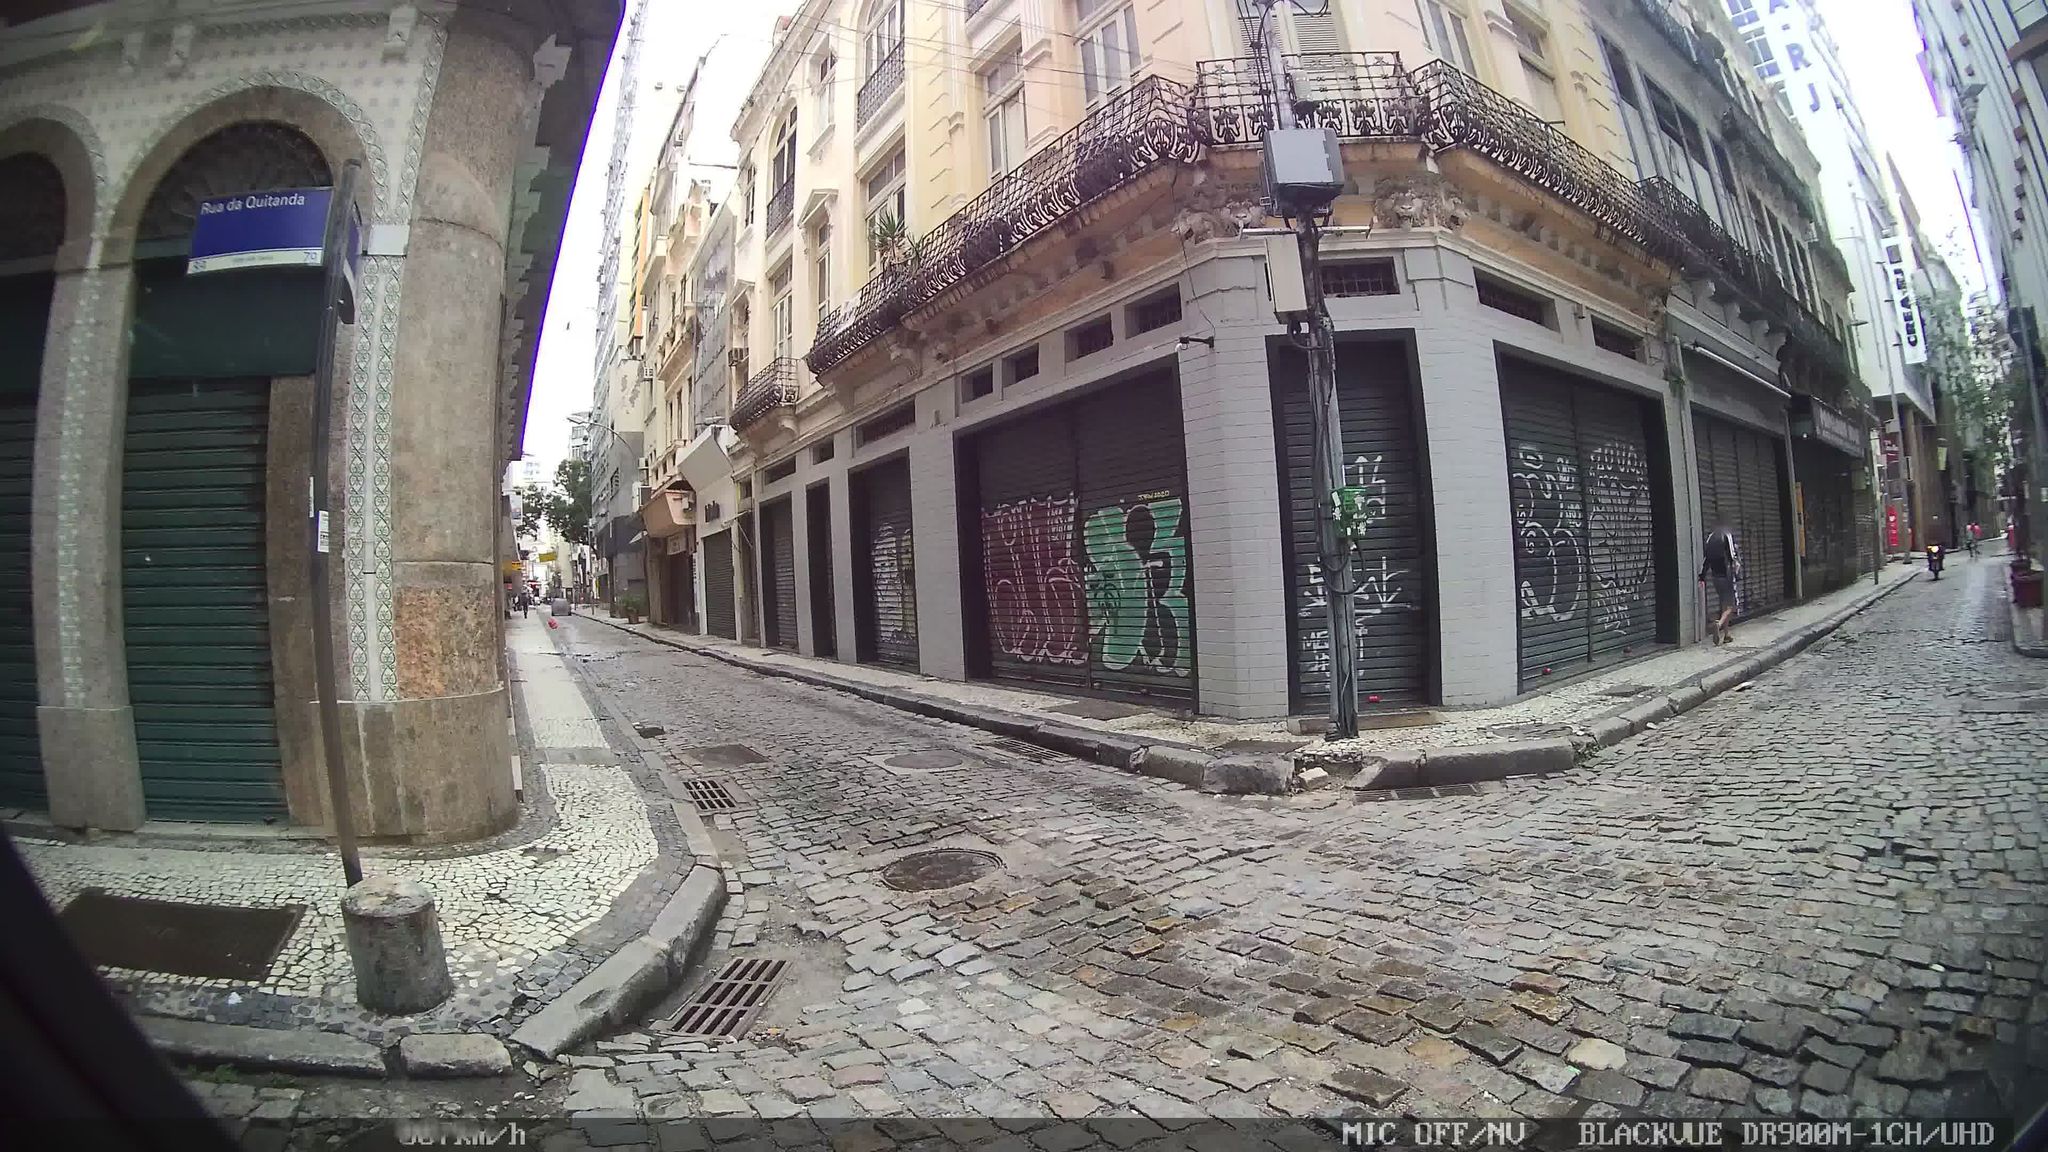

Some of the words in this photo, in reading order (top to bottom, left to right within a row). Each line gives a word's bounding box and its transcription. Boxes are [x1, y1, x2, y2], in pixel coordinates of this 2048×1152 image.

[201, 202, 225, 215] Rua
[227, 198, 242, 212] da
[246, 194, 305, 209] Quitanda
